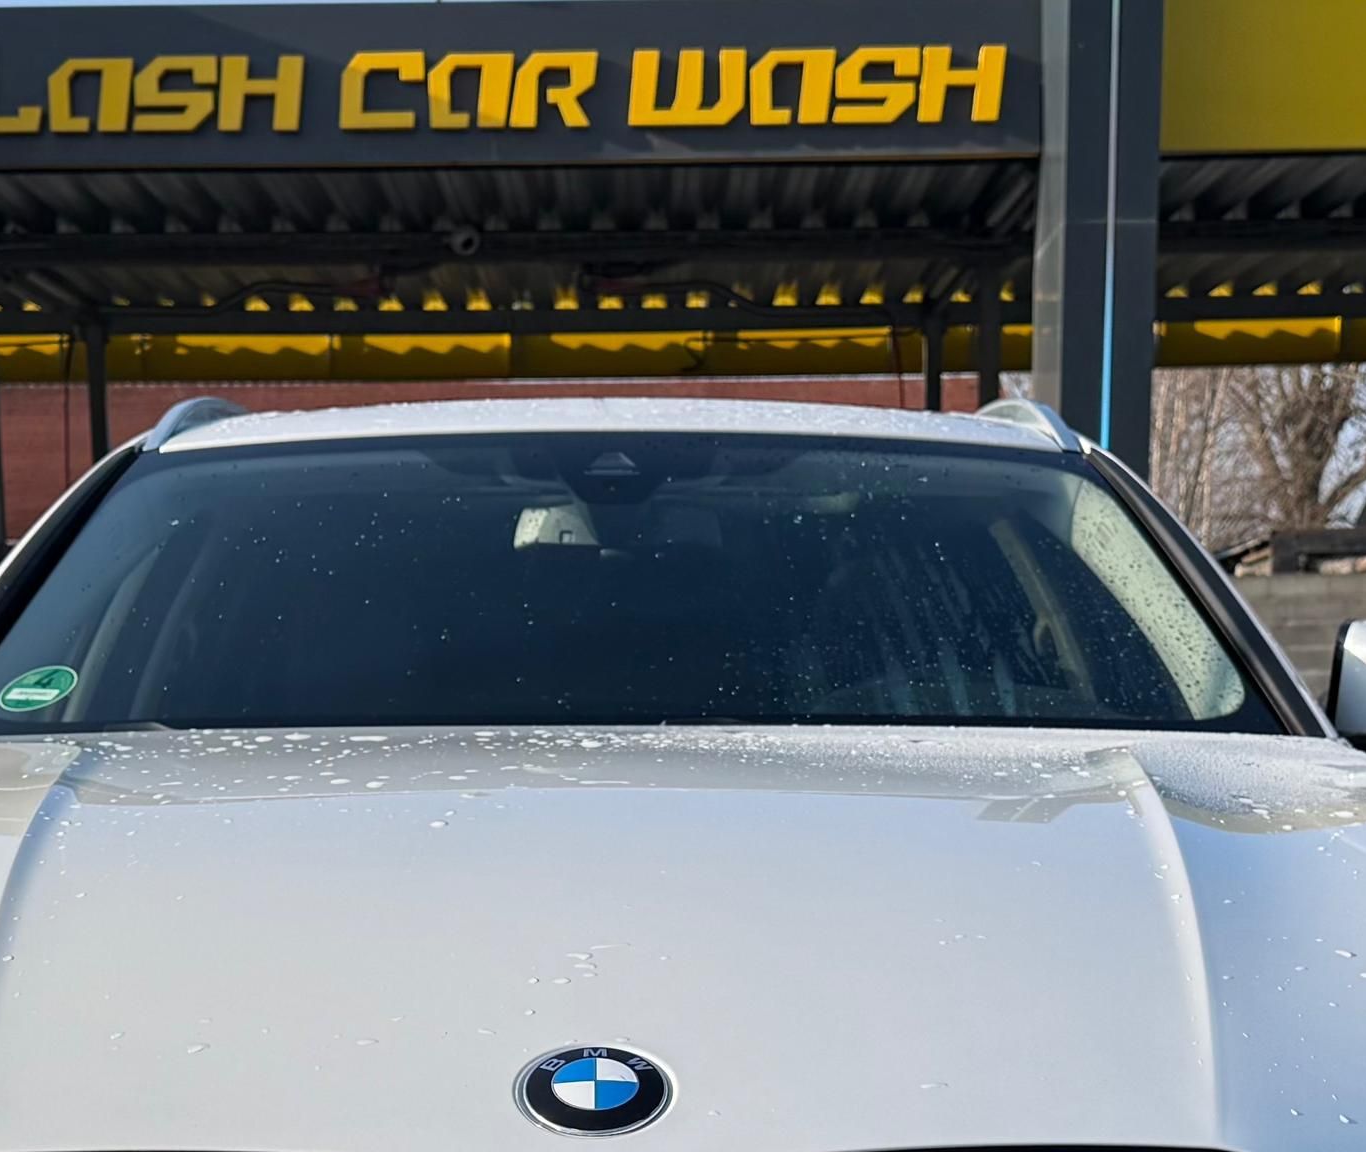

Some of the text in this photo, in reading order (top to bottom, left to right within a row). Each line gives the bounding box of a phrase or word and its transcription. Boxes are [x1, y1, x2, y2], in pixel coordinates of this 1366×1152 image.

[339, 50, 599, 130] CAR
[627, 44, 1008, 126] WASH
[538, 1048, 655, 1072] BMW
